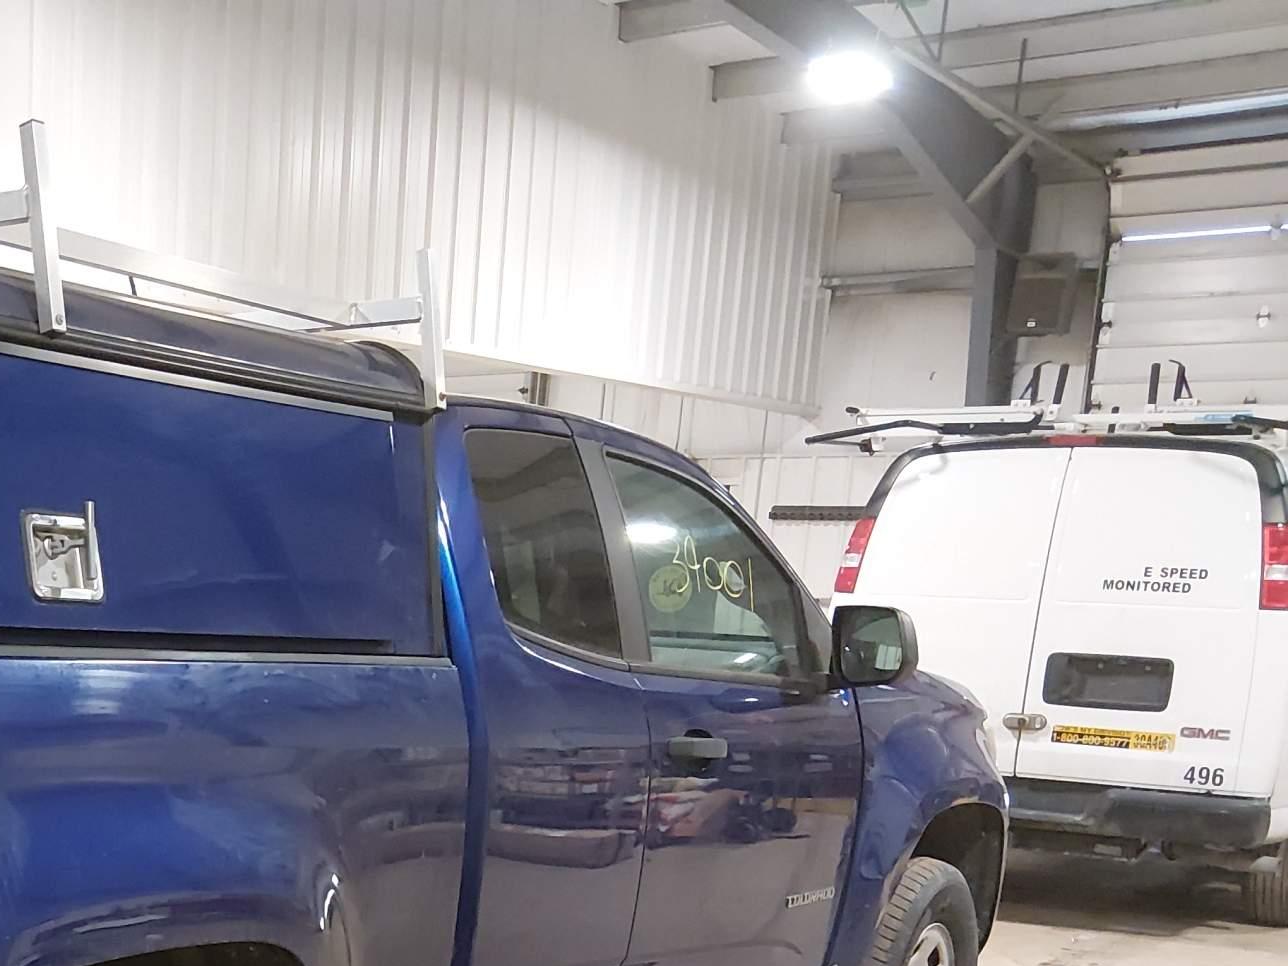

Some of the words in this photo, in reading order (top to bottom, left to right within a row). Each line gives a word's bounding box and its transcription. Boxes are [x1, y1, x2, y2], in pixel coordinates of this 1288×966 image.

[1159, 567, 1209, 580] SPEED
[1102, 579, 1192, 593] MONITORED
[1180, 726, 1232, 741] GMC
[1183, 765, 1225, 787] 496
